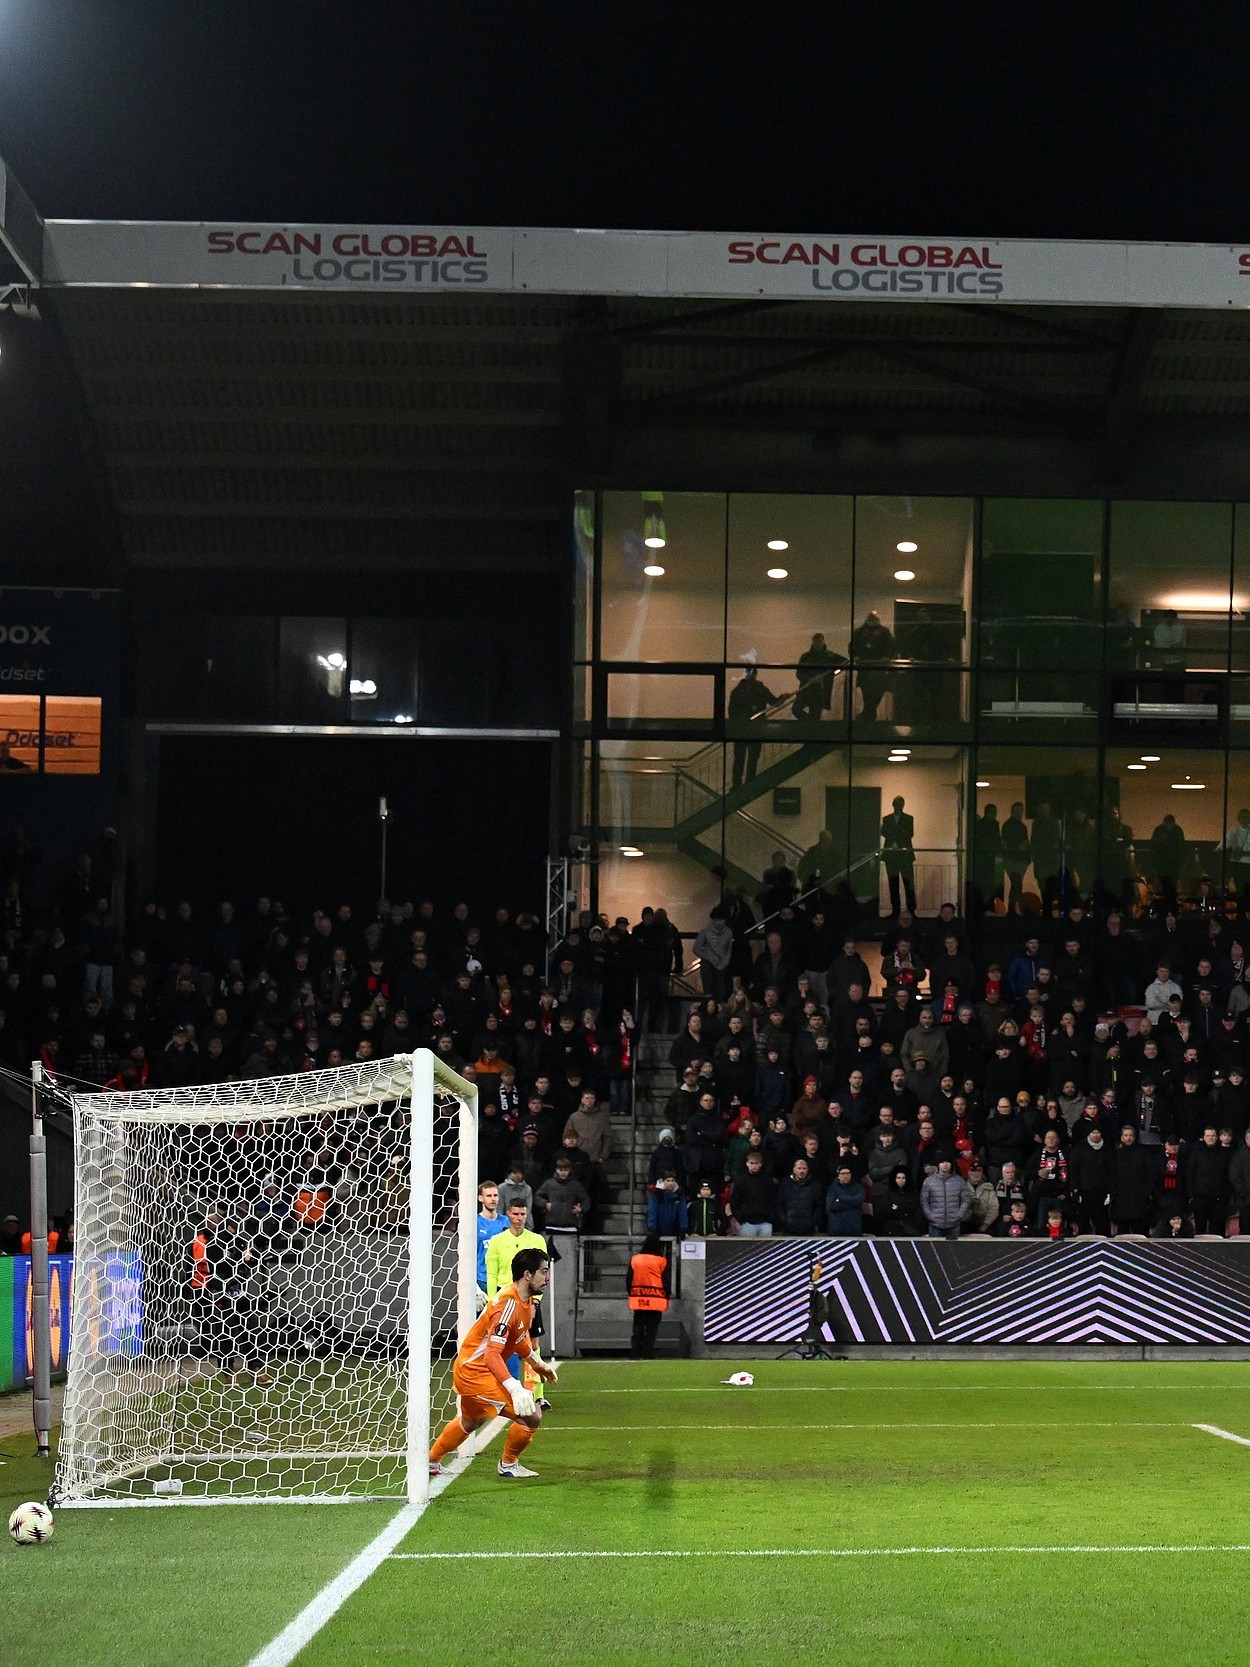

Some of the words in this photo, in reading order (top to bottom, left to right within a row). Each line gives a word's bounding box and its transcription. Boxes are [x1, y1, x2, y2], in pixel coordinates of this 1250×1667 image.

[207, 231, 322, 255] SCAN
[332, 233, 488, 258] GLOBAL
[727, 241, 840, 266] SCAN
[850, 243, 1003, 269] GLOBAL
[293, 258, 489, 284] LOGISTICS
[811, 267, 1004, 294] LOGISTICS
